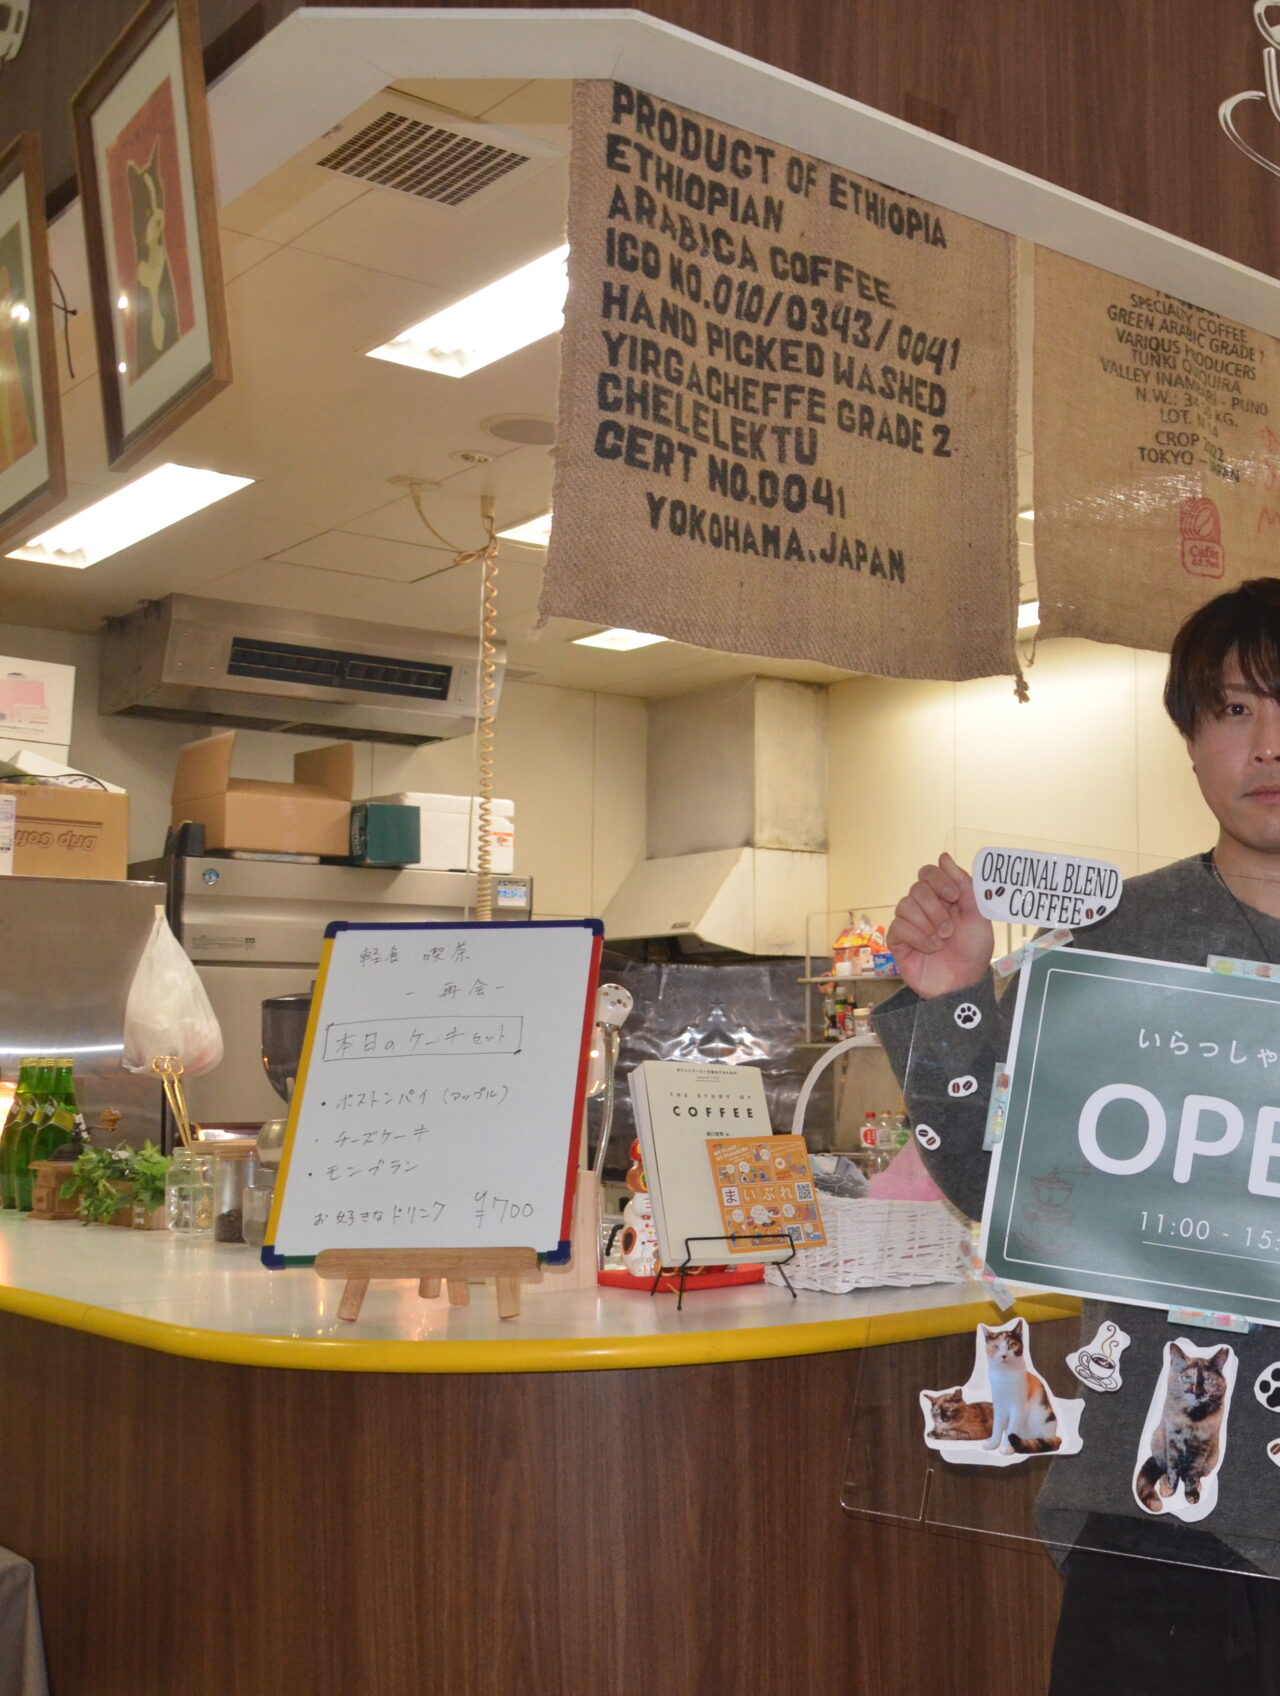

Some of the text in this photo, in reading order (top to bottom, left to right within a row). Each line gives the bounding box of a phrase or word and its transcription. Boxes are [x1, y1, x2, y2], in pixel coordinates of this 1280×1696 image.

[606, 133, 784, 234] ETHIOPIAN
[611, 82, 948, 249] PRODUCT OF ETHIOPIA
[606, 227, 661, 280] ICO
[607, 183, 897, 310] ARABICA COFFEE
[1106, 304, 1155, 331] GREEN
[1209, 337, 1258, 362] GRADE
[1130, 293, 1193, 324] SPECIALTY
[1197, 316, 1248, 343] COFFEE
[602, 281, 947, 417] HAND PICKED WASHED
[1115, 327, 1181, 355] VARIOUS
[1131, 349, 1177, 370] TUNKI
[602, 330, 953, 458] YIRGACHEFFE GRADE 2
[1100, 355, 1151, 384] VALLEY
[1231, 395, 1269, 416] PUNO
[598, 372, 818, 467] CHELELEKTU
[1155, 429, 1200, 447] CROP
[594, 419, 698, 484] CERT
[1137, 446, 1194, 465] TOKYO
[57, 832, 99, 852] Drip
[981, 852, 1119, 899] ORIGINAL BLEND
[1009, 888, 1085, 926] COFFEE
[334, 1024, 507, 1054] 本日のケーキセット
[672, 1105, 754, 1119] COFFEE
[335, 1123, 431, 1146] チーズケーキ
[327, 1159, 419, 1182] モンブラン
[313, 1190, 535, 1229] お好きなドリンク ¥700
[1139, 1210, 1211, 1241] 11:00
